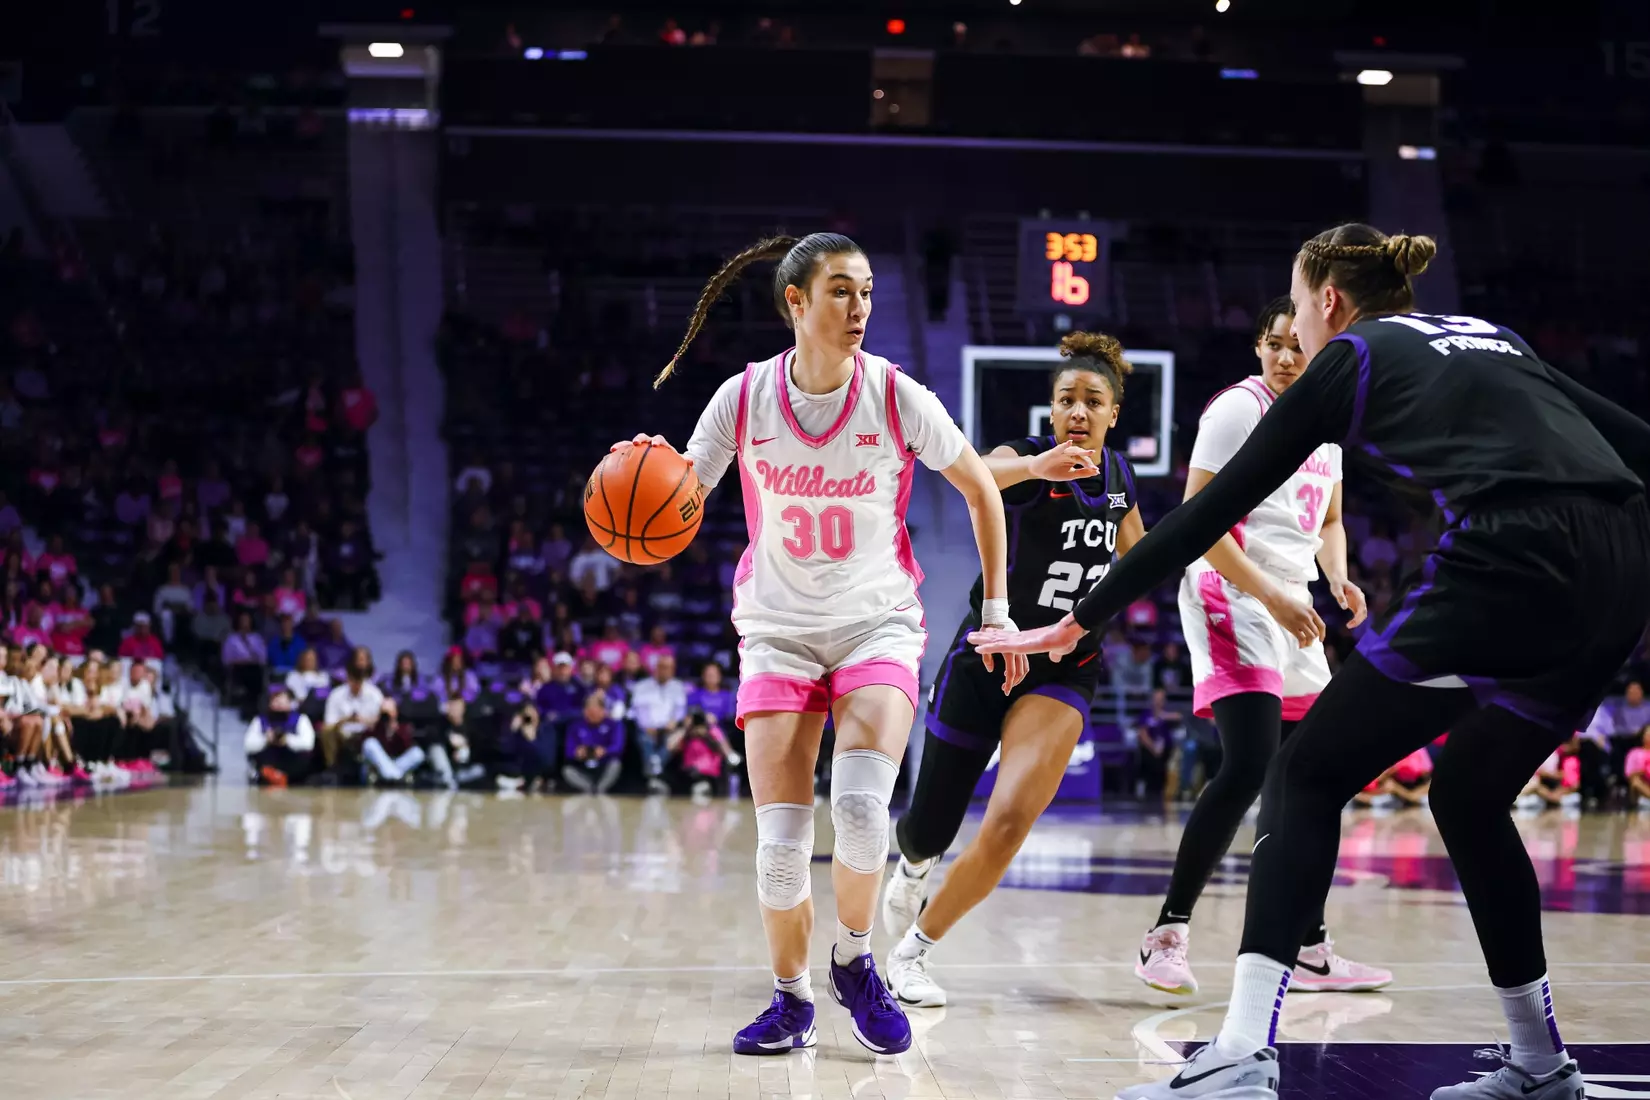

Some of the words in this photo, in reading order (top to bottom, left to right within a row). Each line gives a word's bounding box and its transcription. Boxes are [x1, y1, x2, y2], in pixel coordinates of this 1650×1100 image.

[1051, 261, 1090, 305] 16
[756, 459, 877, 498] Wildcats
[781, 505, 855, 561] 30
[1061, 519, 1118, 553] TCU
